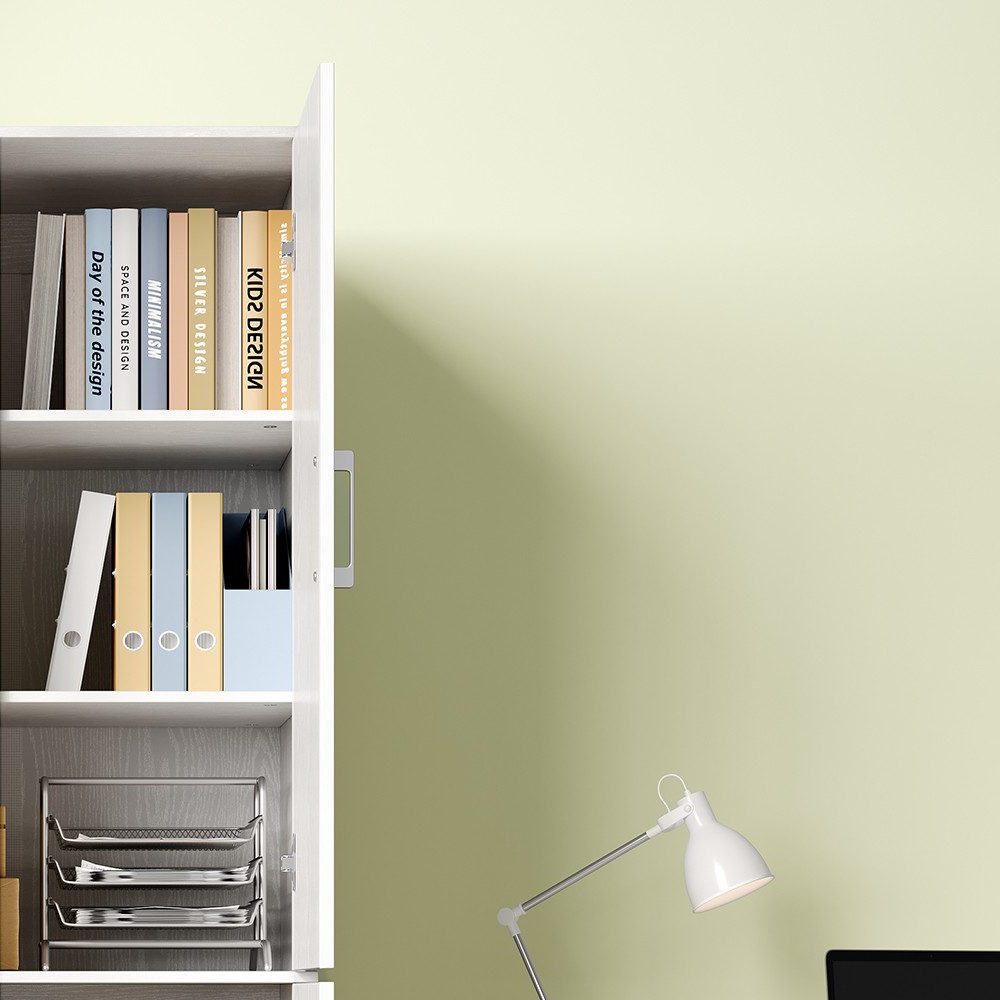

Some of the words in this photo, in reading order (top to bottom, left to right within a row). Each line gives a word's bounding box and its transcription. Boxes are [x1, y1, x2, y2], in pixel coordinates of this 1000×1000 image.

[88, 250, 105, 284] Day
[120, 265, 130, 300] SPACE
[91, 287, 105, 307] of
[194, 267, 207, 317] SILVER
[91, 309, 105, 337] the
[120, 303, 130, 327] AND
[147, 279, 162, 361] MINIMALISM
[120, 330, 130, 372] DESIGN
[194, 323, 207, 375] DESIGN
[88, 341, 105, 397] design
